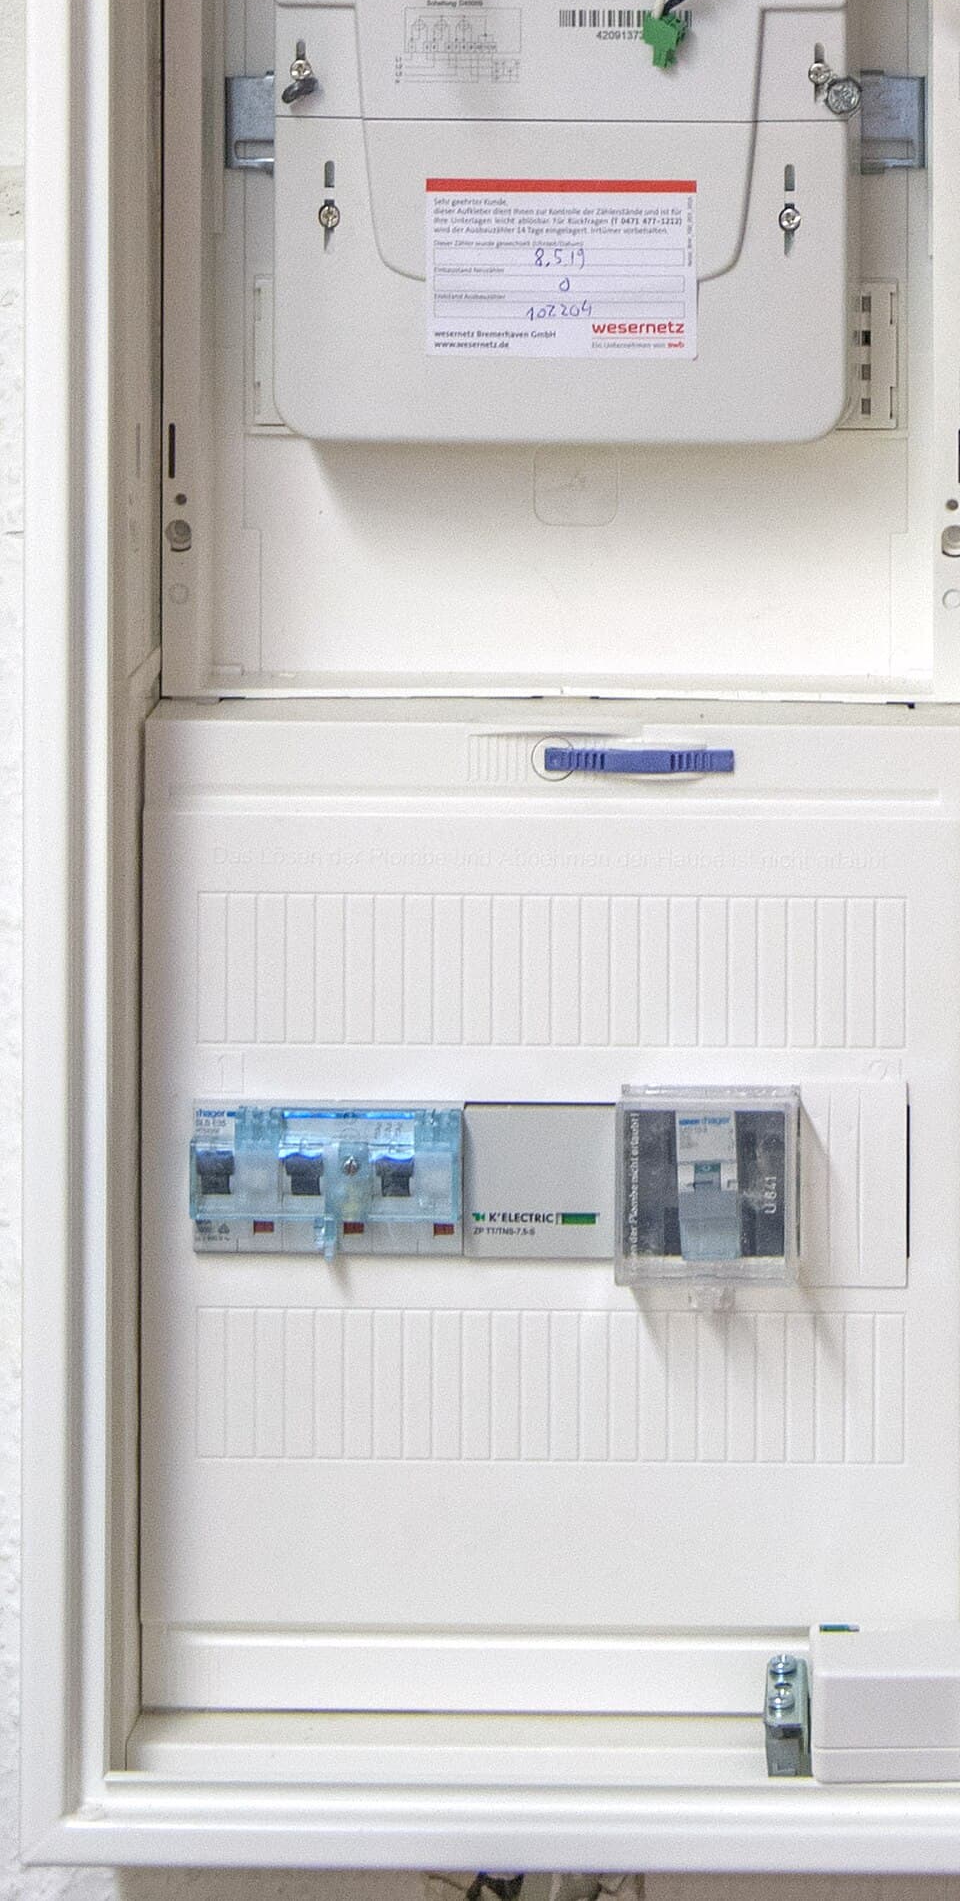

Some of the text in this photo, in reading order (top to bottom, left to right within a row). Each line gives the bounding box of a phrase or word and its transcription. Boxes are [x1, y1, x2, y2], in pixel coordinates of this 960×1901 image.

[592, 321, 685, 335] wesernetz
[476, 330, 529, 338] Bremerhaven
[530, 330, 556, 338] GmbH
[434, 341, 510, 349] www.wesernetz.de
[628, 1185, 639, 1224] Plombe
[764, 1207, 777, 1215] U
[489, 1213, 554, 1224] K'ELECTRIC
